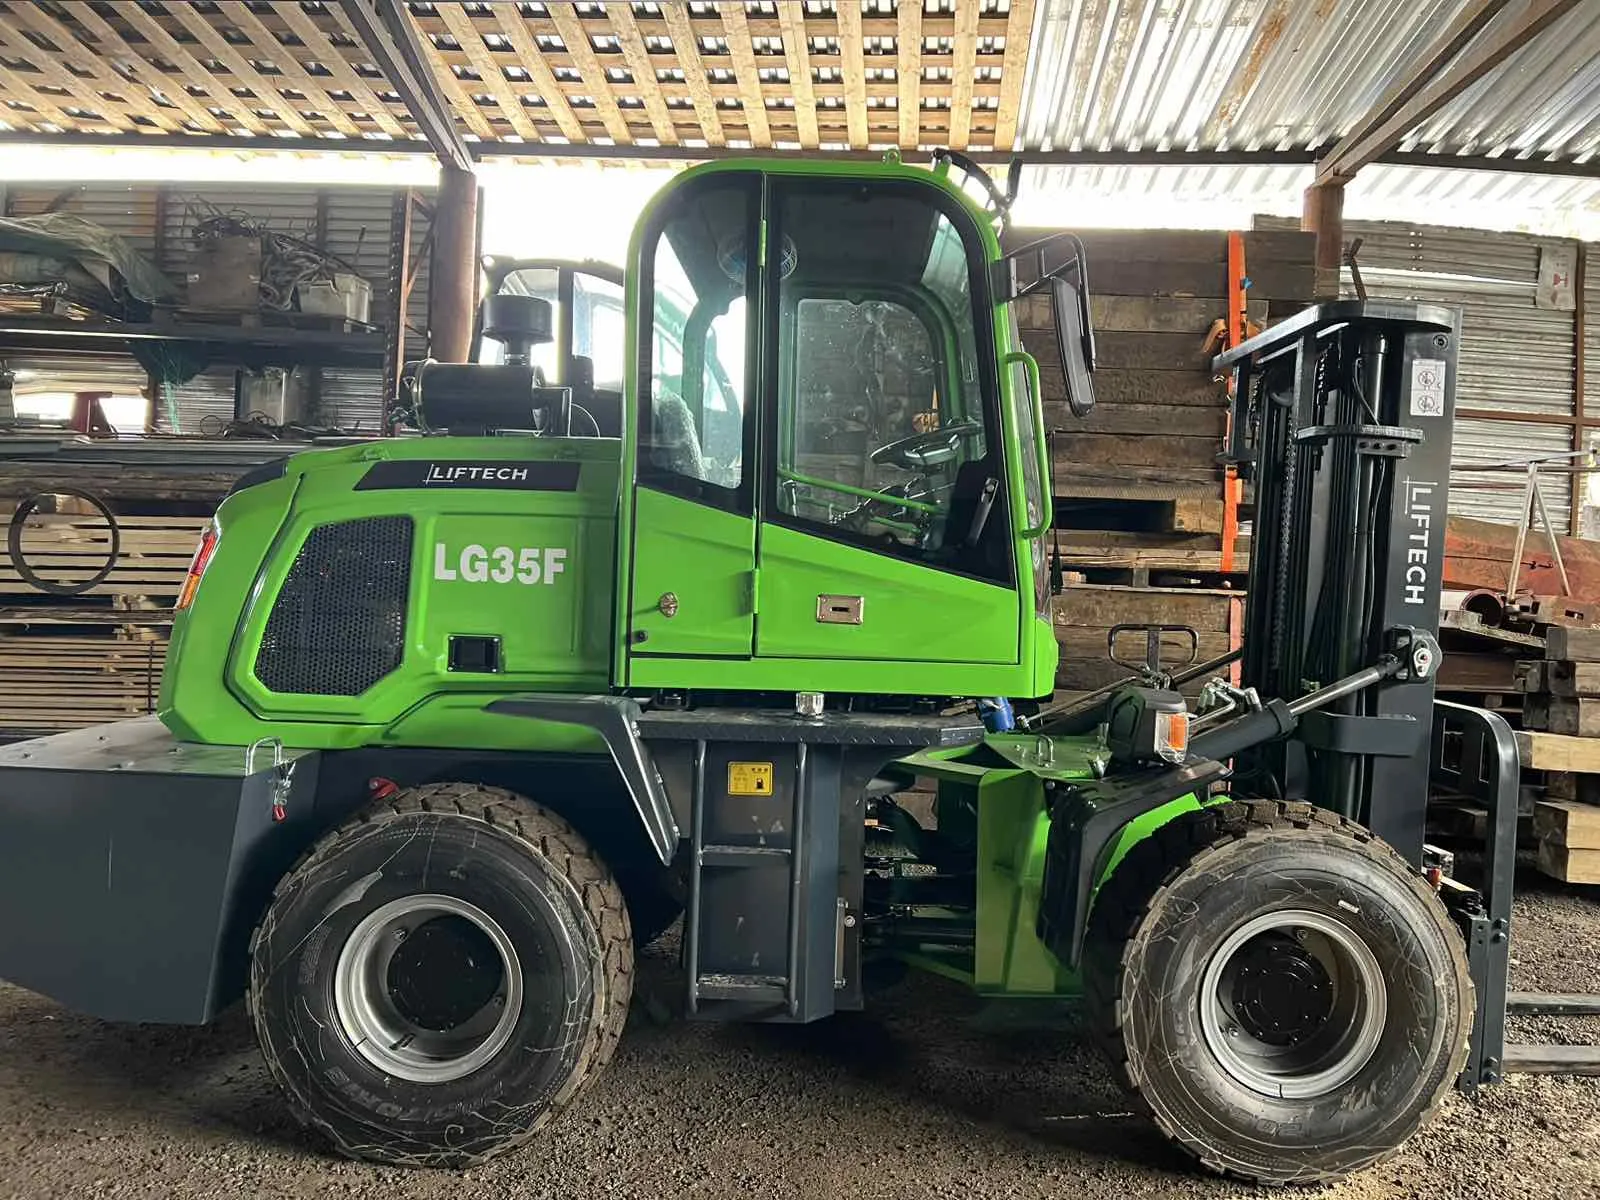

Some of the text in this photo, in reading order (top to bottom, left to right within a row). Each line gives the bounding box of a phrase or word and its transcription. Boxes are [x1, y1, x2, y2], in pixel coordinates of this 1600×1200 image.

[428, 466, 529, 481] LIFTECH
[434, 543, 567, 584] LG35F
[1404, 483, 1433, 604] LIFTECH
